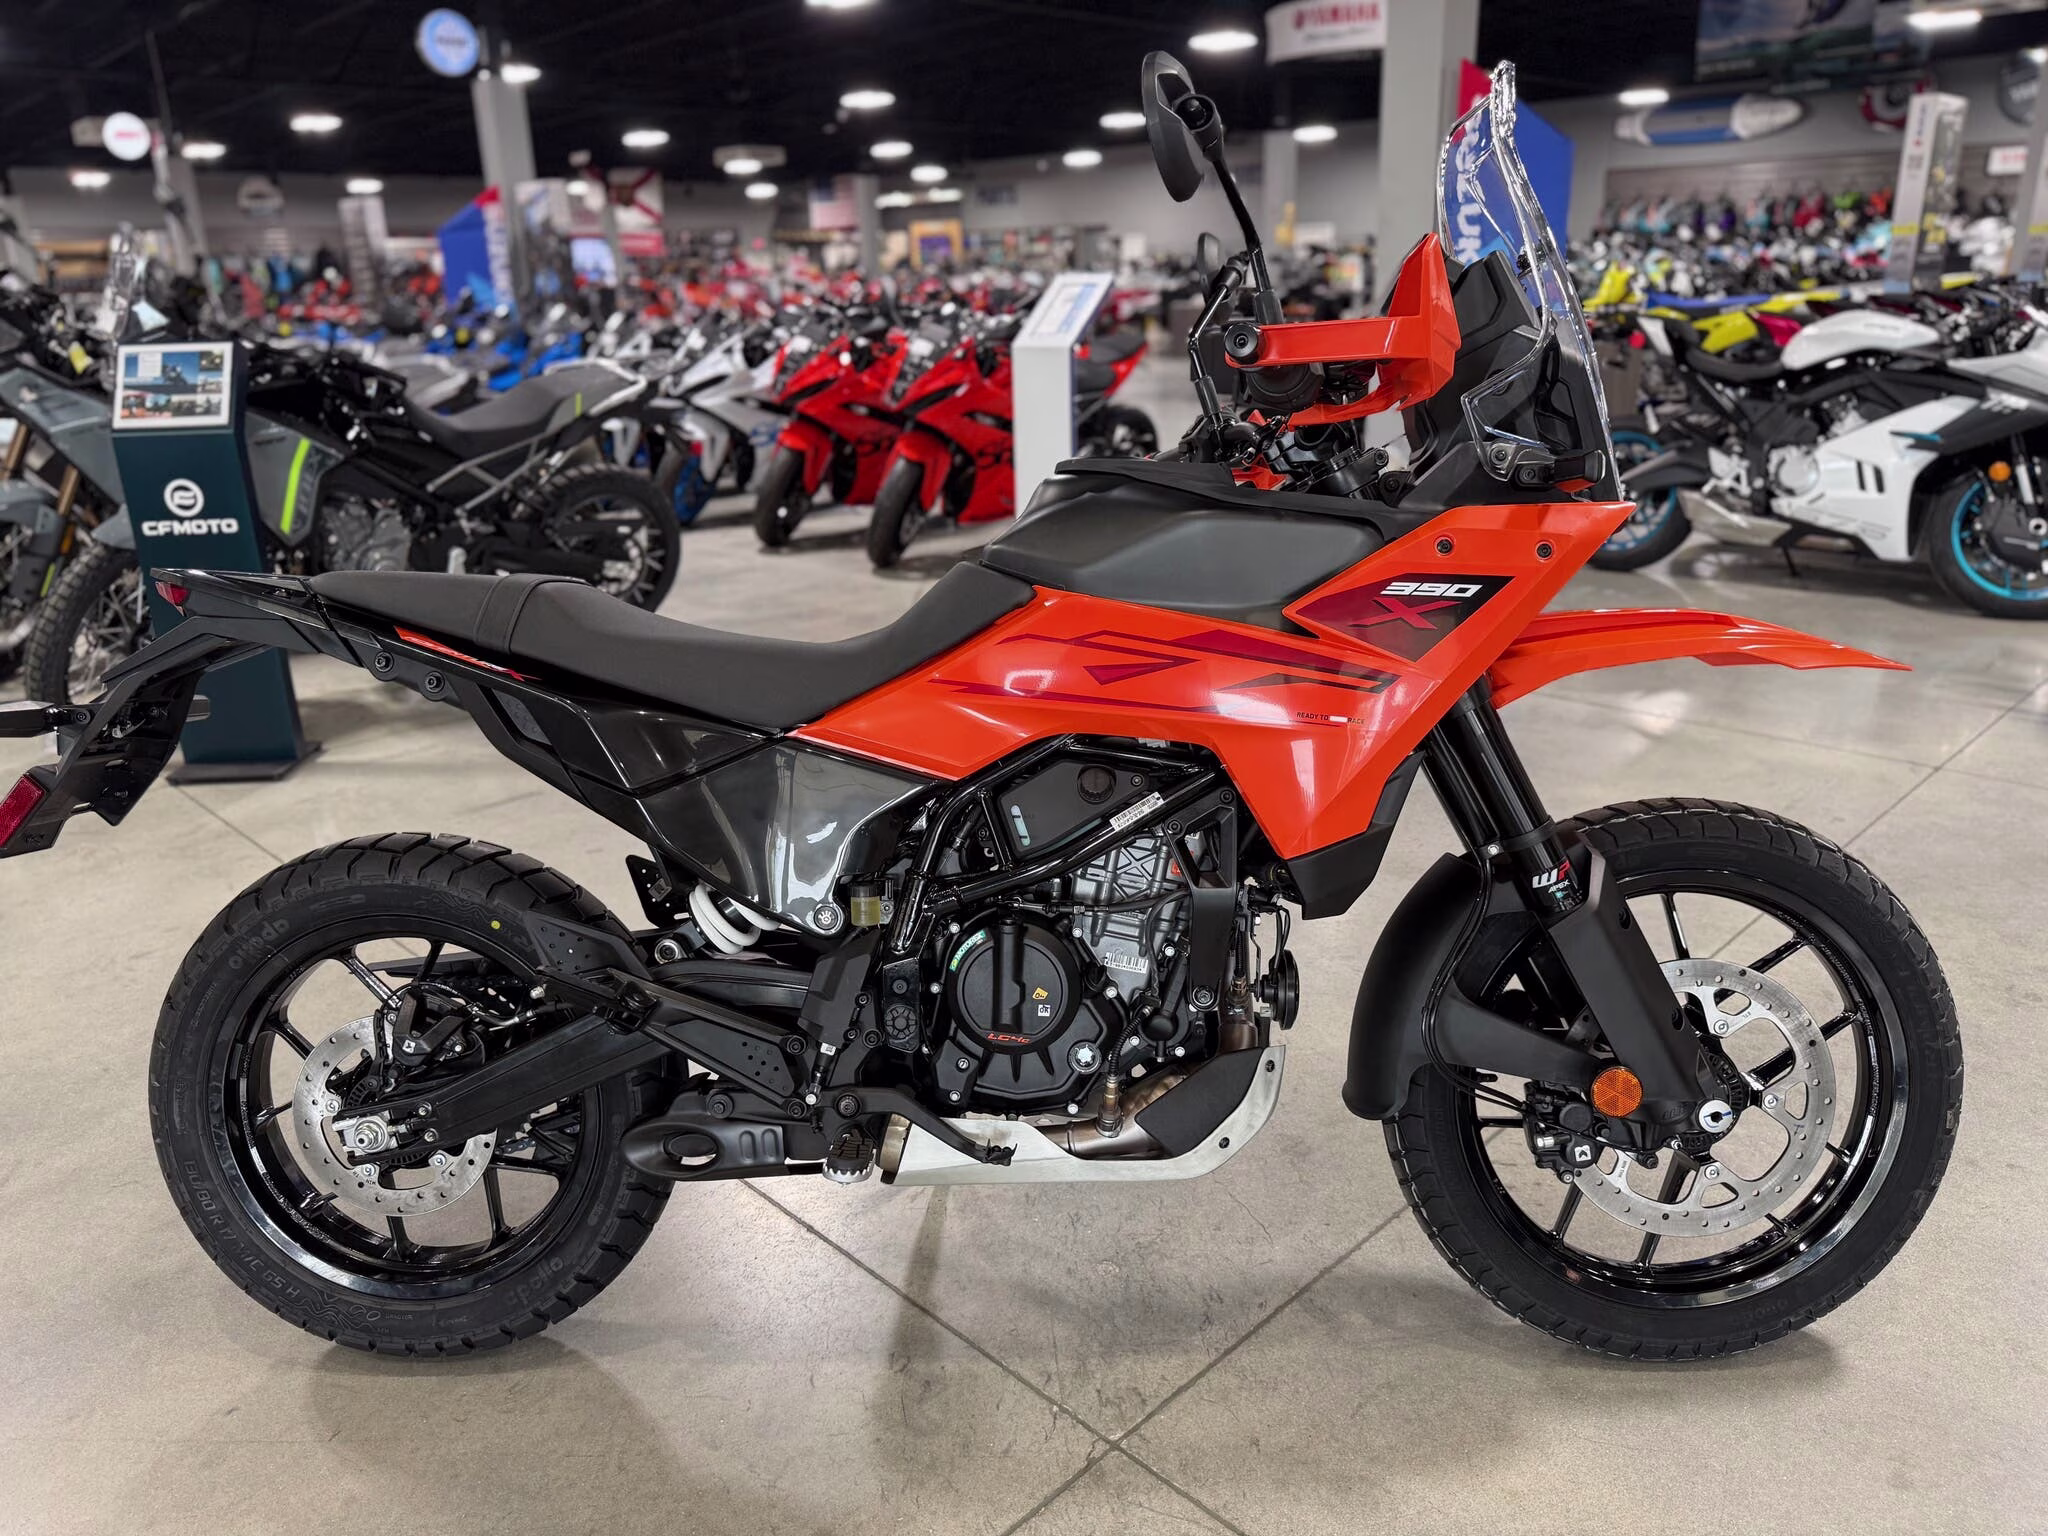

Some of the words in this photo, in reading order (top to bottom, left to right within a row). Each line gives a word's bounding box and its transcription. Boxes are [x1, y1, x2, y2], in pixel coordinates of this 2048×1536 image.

[141, 517, 240, 537] CFMOTO
[1380, 581, 1484, 598] 390
[1296, 711, 1319, 721] READY
[1319, 713, 1329, 721] TO
[1532, 861, 1571, 889] WP
[1547, 879, 1571, 894] APEX
